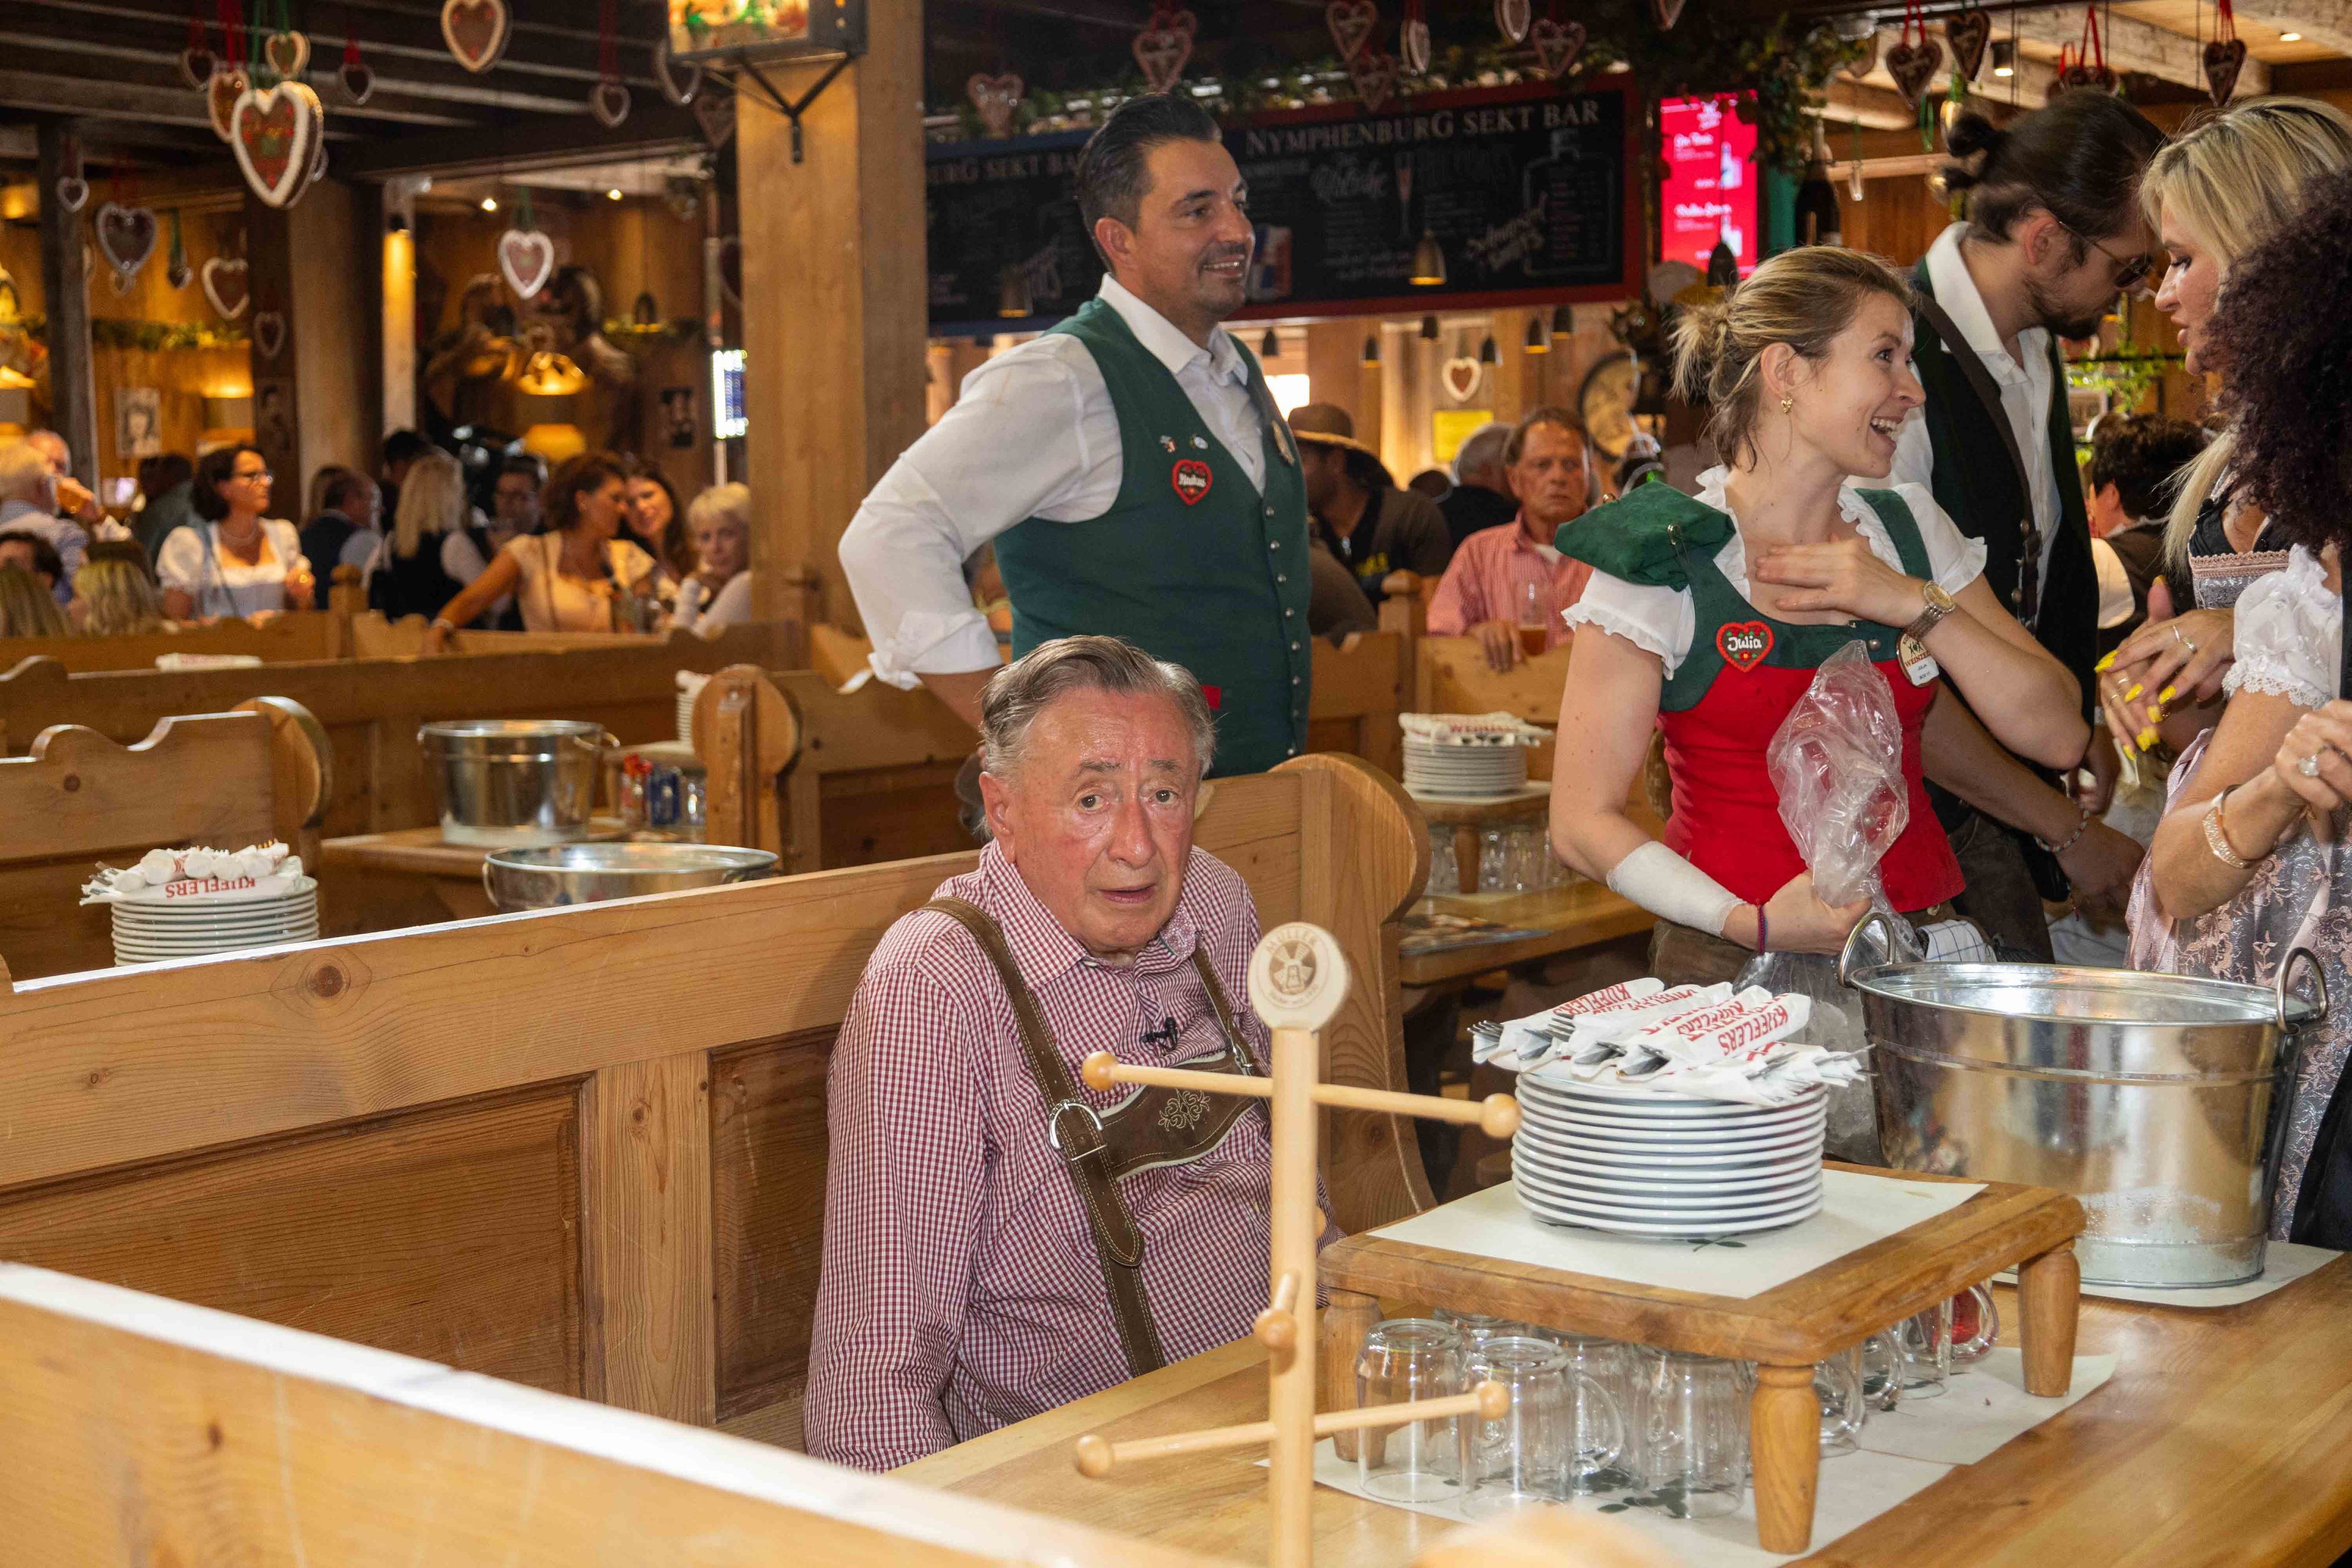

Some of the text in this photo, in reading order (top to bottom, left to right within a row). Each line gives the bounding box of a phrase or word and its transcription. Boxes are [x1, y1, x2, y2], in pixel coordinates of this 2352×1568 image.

[1246, 99, 1600, 156] NYMPHENBURG SEKT BAR
[1728, 636, 1762, 651] Julia
[1905, 650, 1932, 668] WEINZEL
[1718, 1004, 1788, 1056] KUFFLERS
